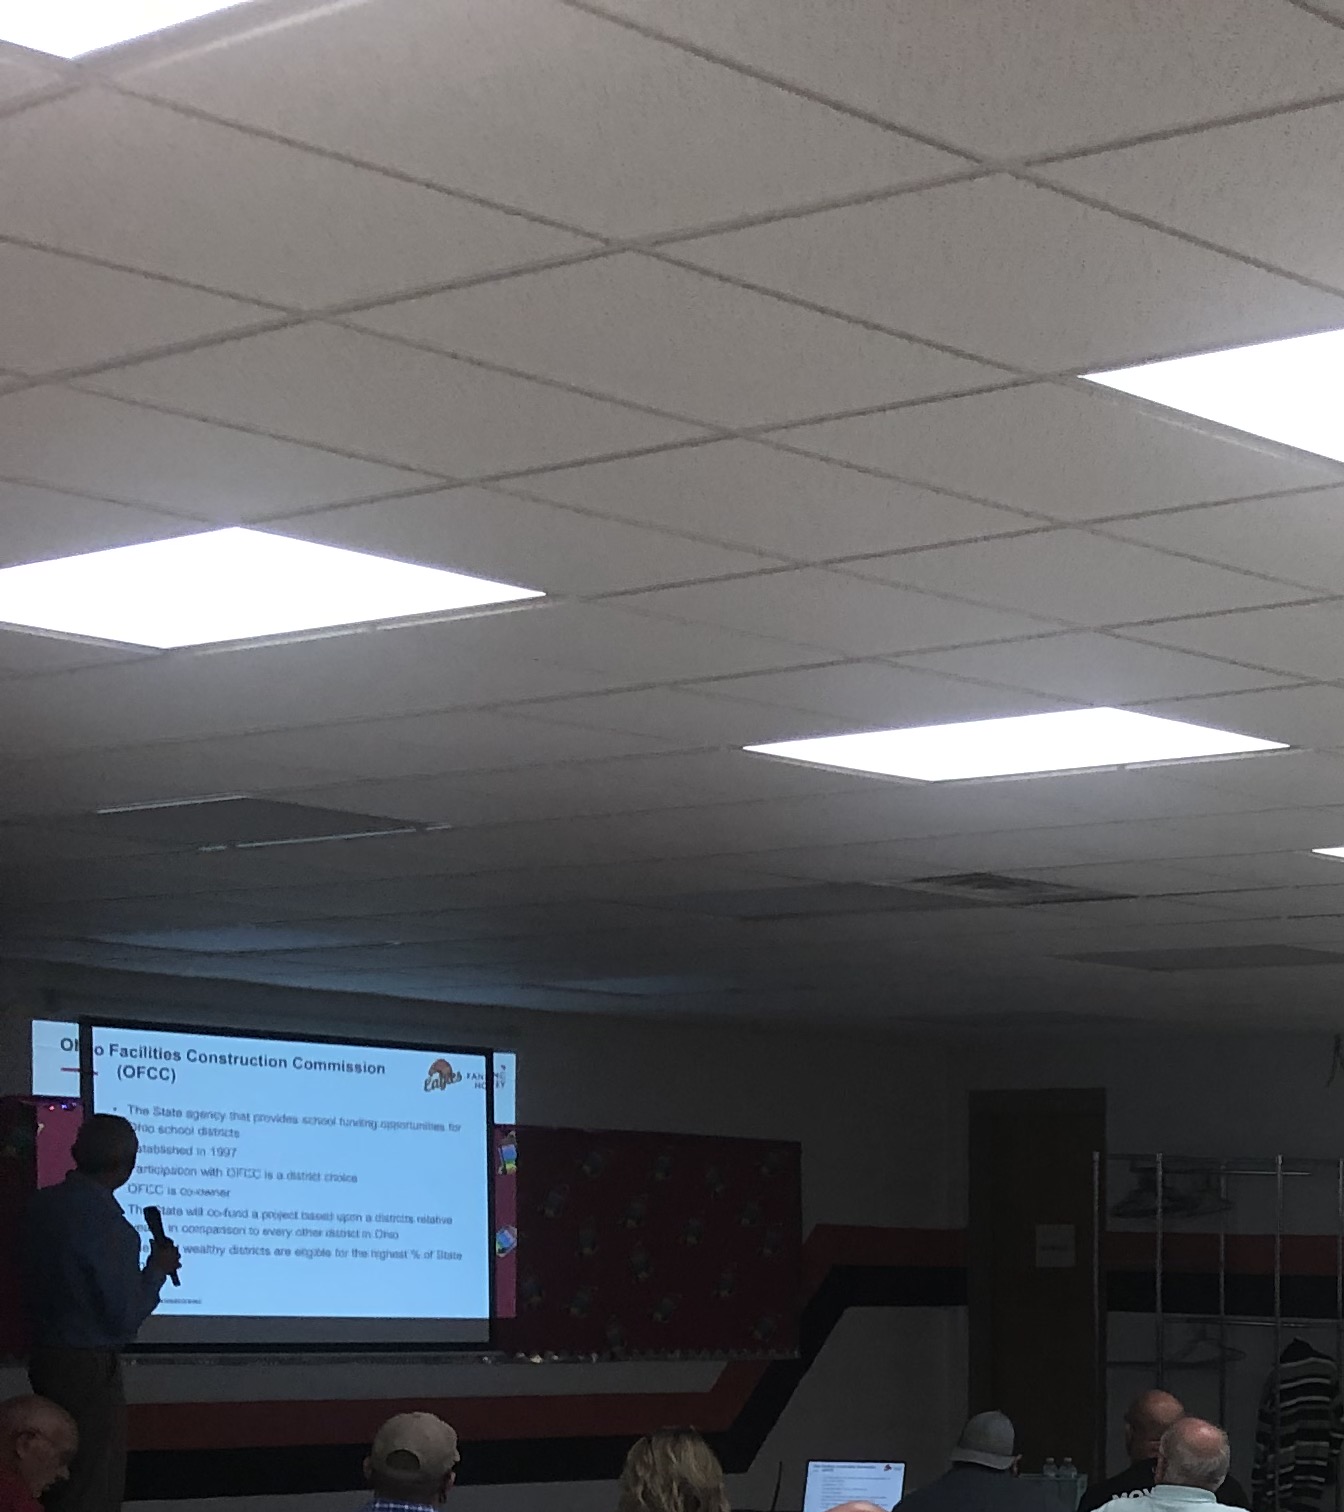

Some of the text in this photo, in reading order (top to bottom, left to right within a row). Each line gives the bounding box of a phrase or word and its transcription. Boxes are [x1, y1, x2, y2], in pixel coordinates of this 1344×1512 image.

[110, 1043, 181, 1061] Facilities
[187, 1049, 288, 1068] Construction
[293, 1056, 386, 1074] Commission
[117, 1064, 176, 1084] (OFCC)
[128, 1104, 149, 1115] The
[153, 1106, 182, 1117] State
[186, 1109, 226, 1122] agency
[229, 1111, 250, 1122] that
[253, 1113, 298, 1124] provides
[302, 1116, 336, 1127] school
[449, 1122, 461, 1132] for
[158, 1124, 194, 1135] school
[198, 1125, 240, 1138] districts
[138, 1144, 237, 1158] stablished in 1997
[136, 1164, 197, 1177] articipation
[201, 1167, 222, 1177] with
[227, 1166, 261, 1178] OFCC
[265, 1169, 273, 1178] is
[286, 1169, 320, 1182] district
[128, 1183, 163, 1195] OFCC
[167, 1186, 176, 1196] is
[128, 1204, 144, 1215] Th
[160, 1206, 183, 1217] tate
[262, 1209, 298, 1221] project
[168, 1223, 178, 1233] in
[262, 1228, 292, 1239] every
[182, 1244, 226, 1257] wealthy
[229, 1246, 271, 1257] districts
[274, 1248, 291, 1257] are
